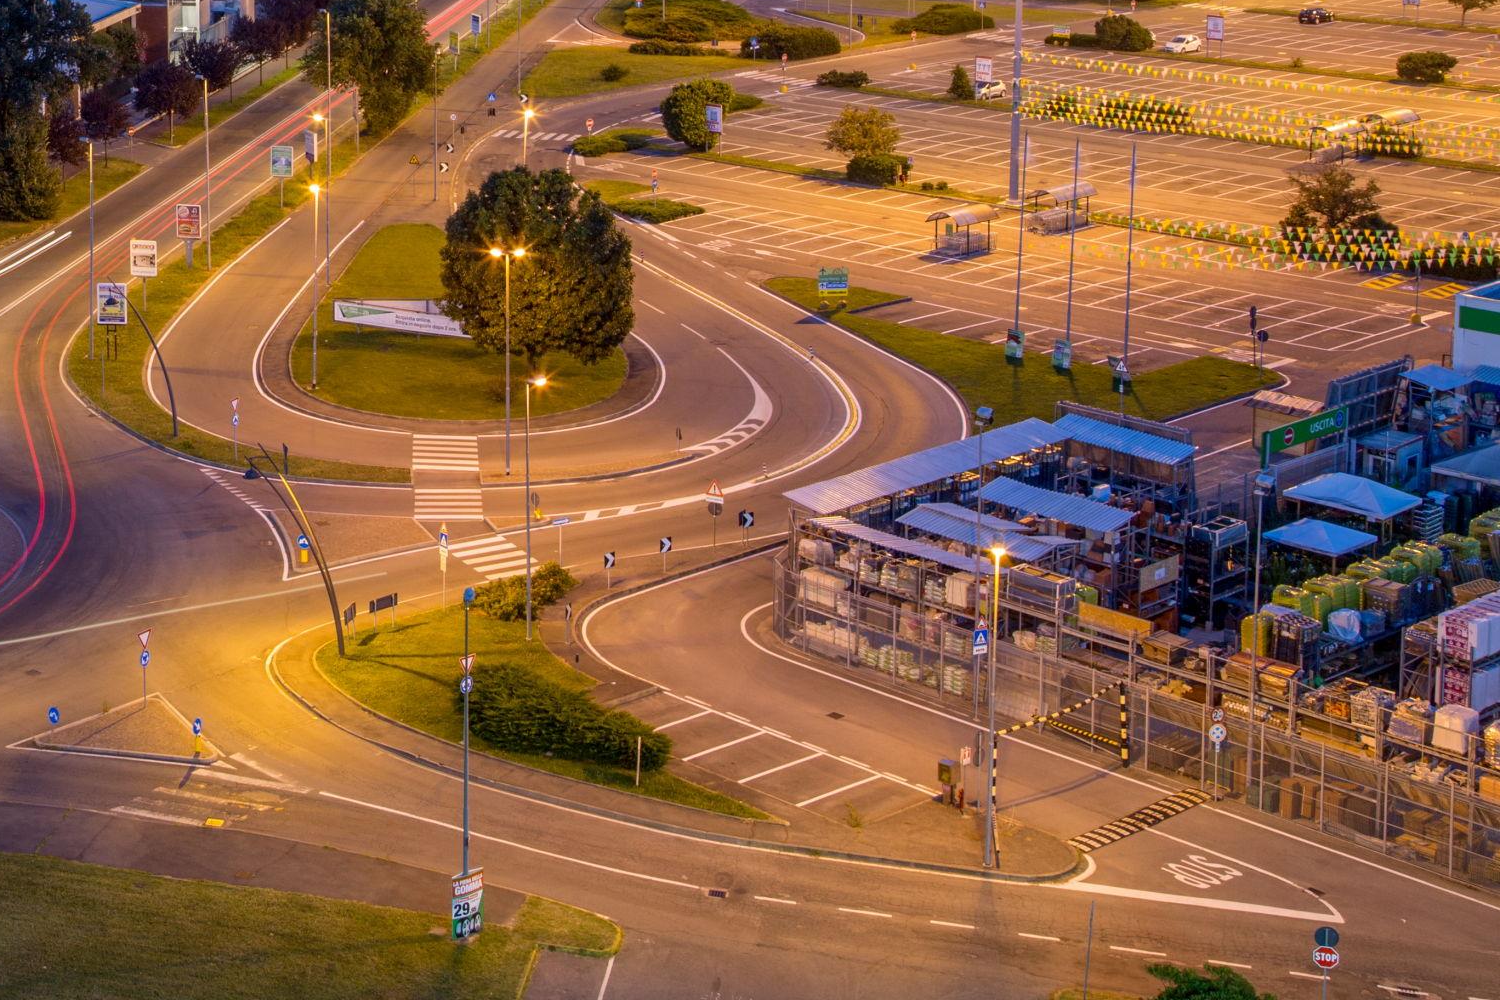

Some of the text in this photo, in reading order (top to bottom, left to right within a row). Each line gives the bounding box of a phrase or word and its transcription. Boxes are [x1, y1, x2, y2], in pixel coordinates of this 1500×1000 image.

[1310, 418, 1334, 433] USCITA
[1160, 854, 1243, 888] STOP
[455, 879, 483, 895] GOMMA
[1315, 951, 1338, 962] STOP
